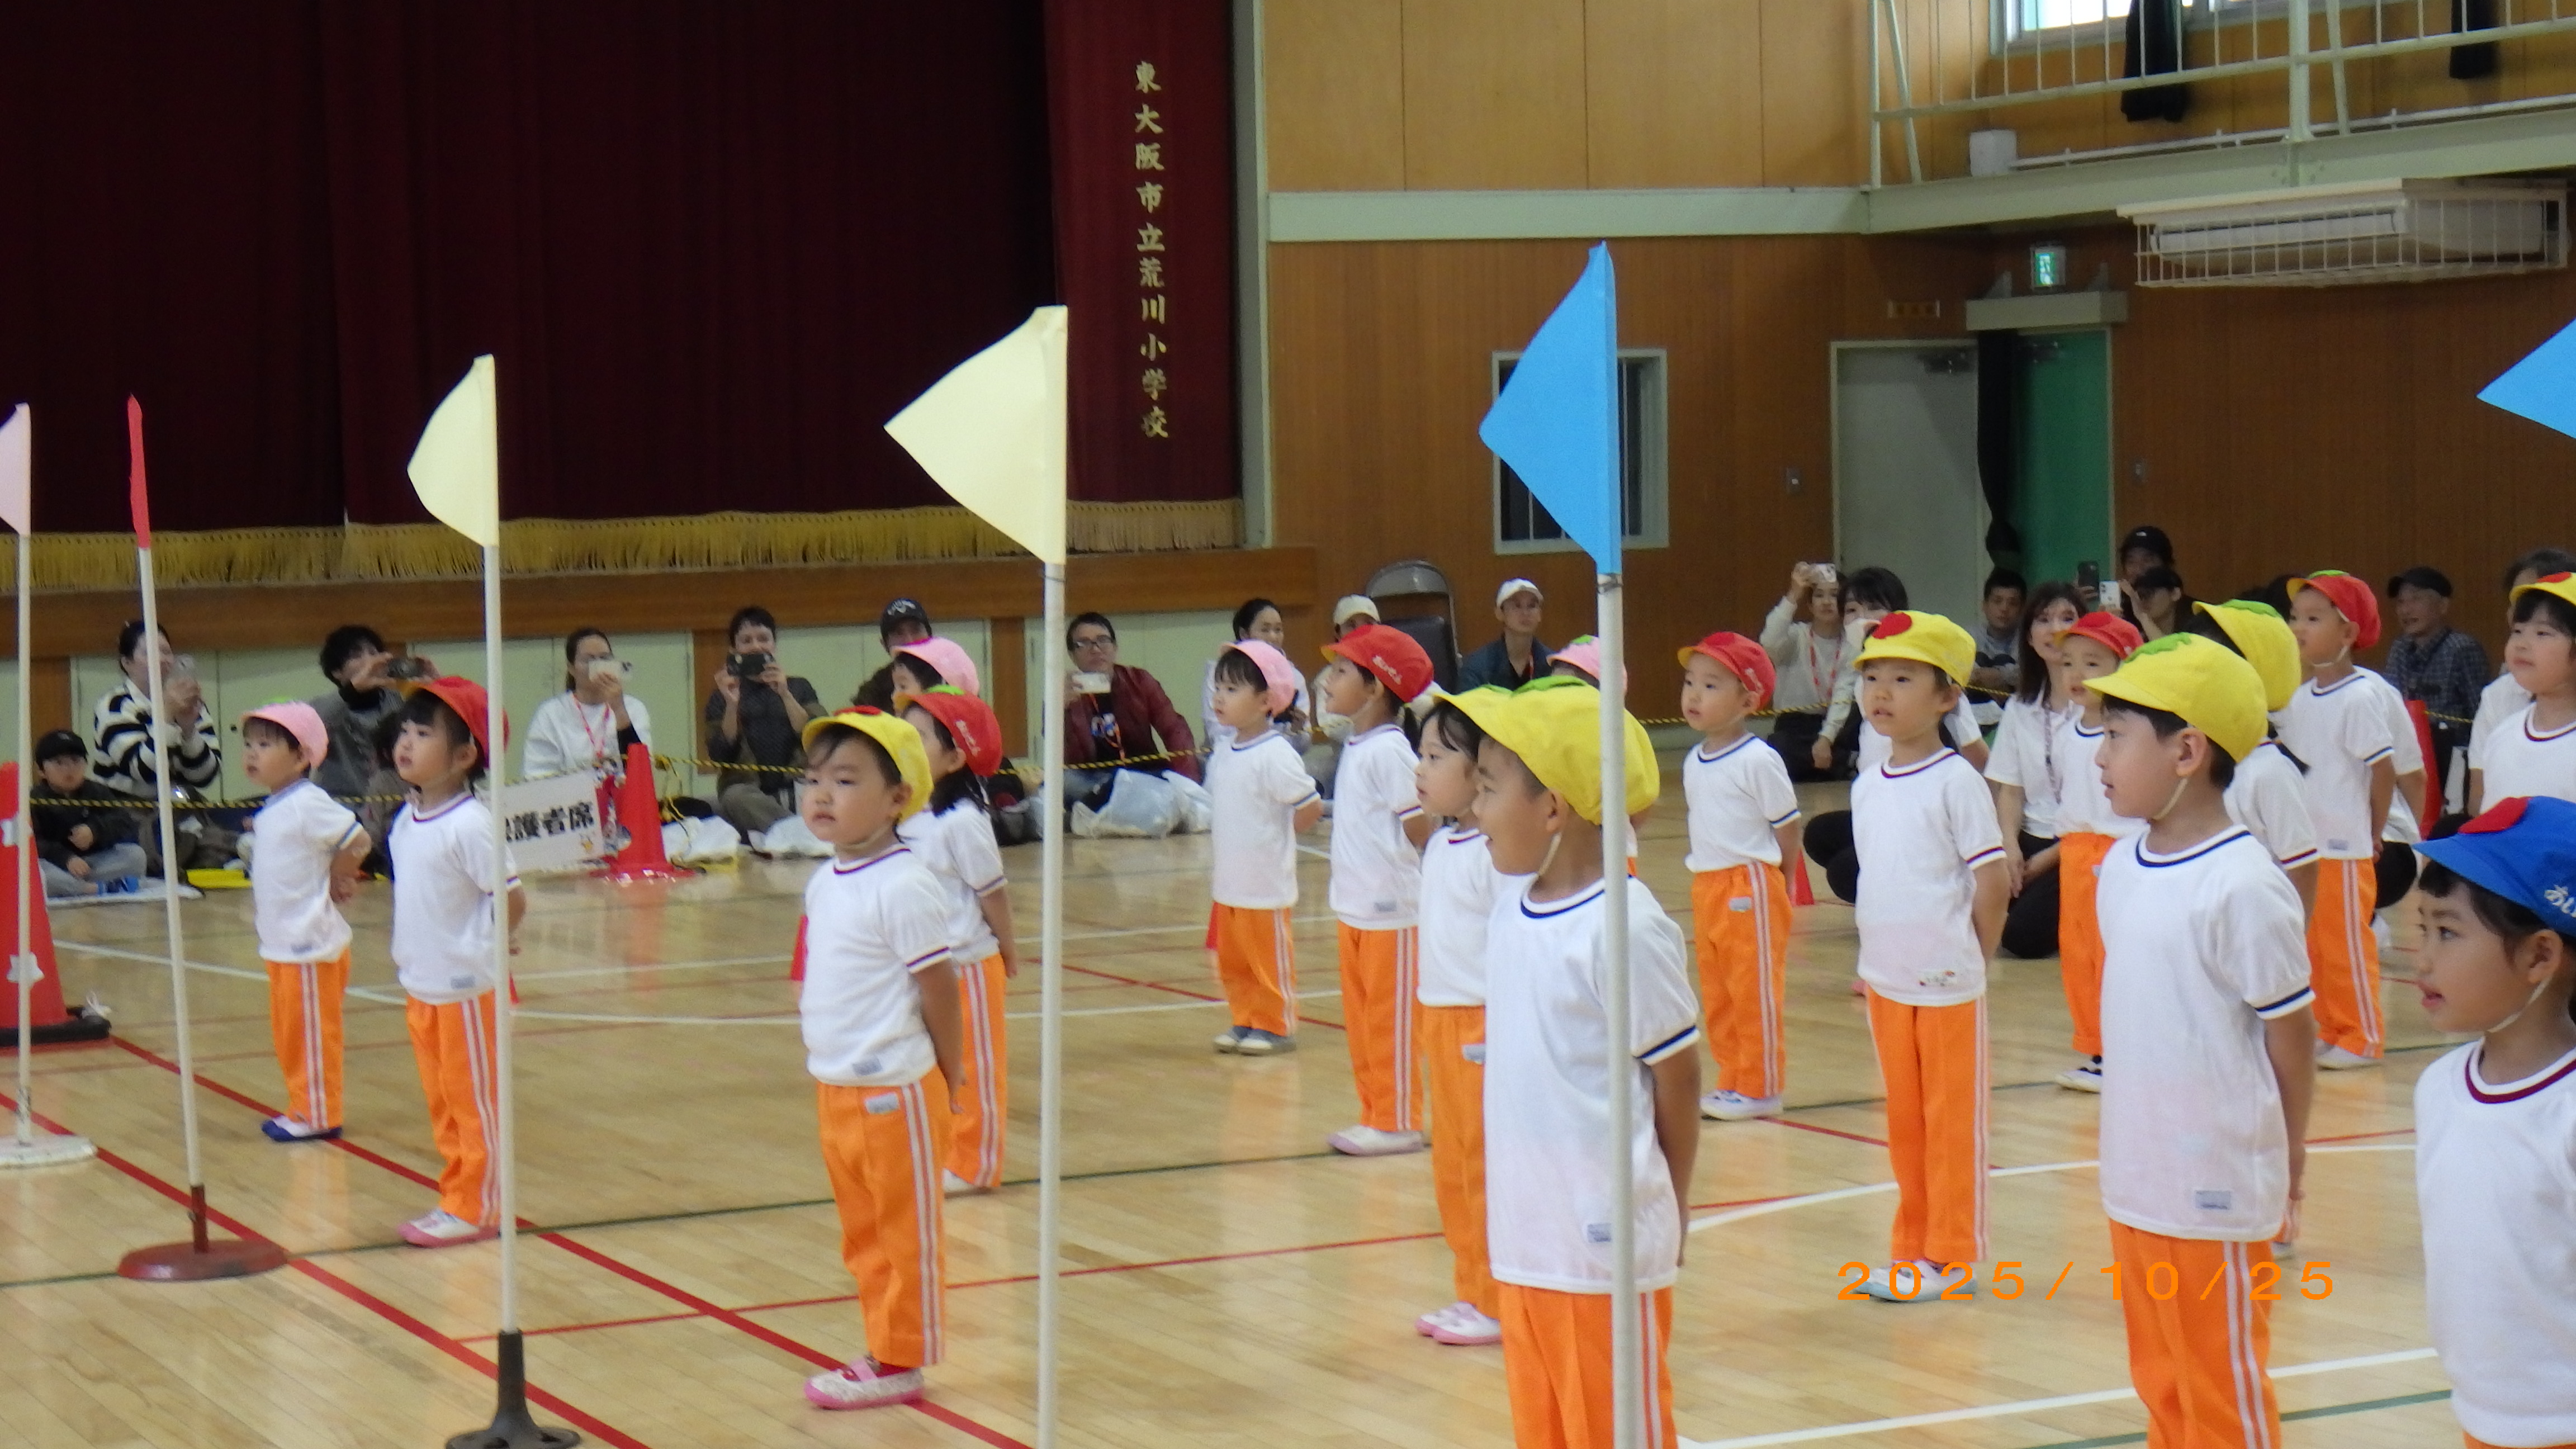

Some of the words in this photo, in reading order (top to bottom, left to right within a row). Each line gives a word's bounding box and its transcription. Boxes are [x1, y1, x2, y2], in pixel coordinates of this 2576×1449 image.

[1134, 60, 1168, 438] 東大阪市立荒川小学校
[505, 801, 595, 842] 護者席
